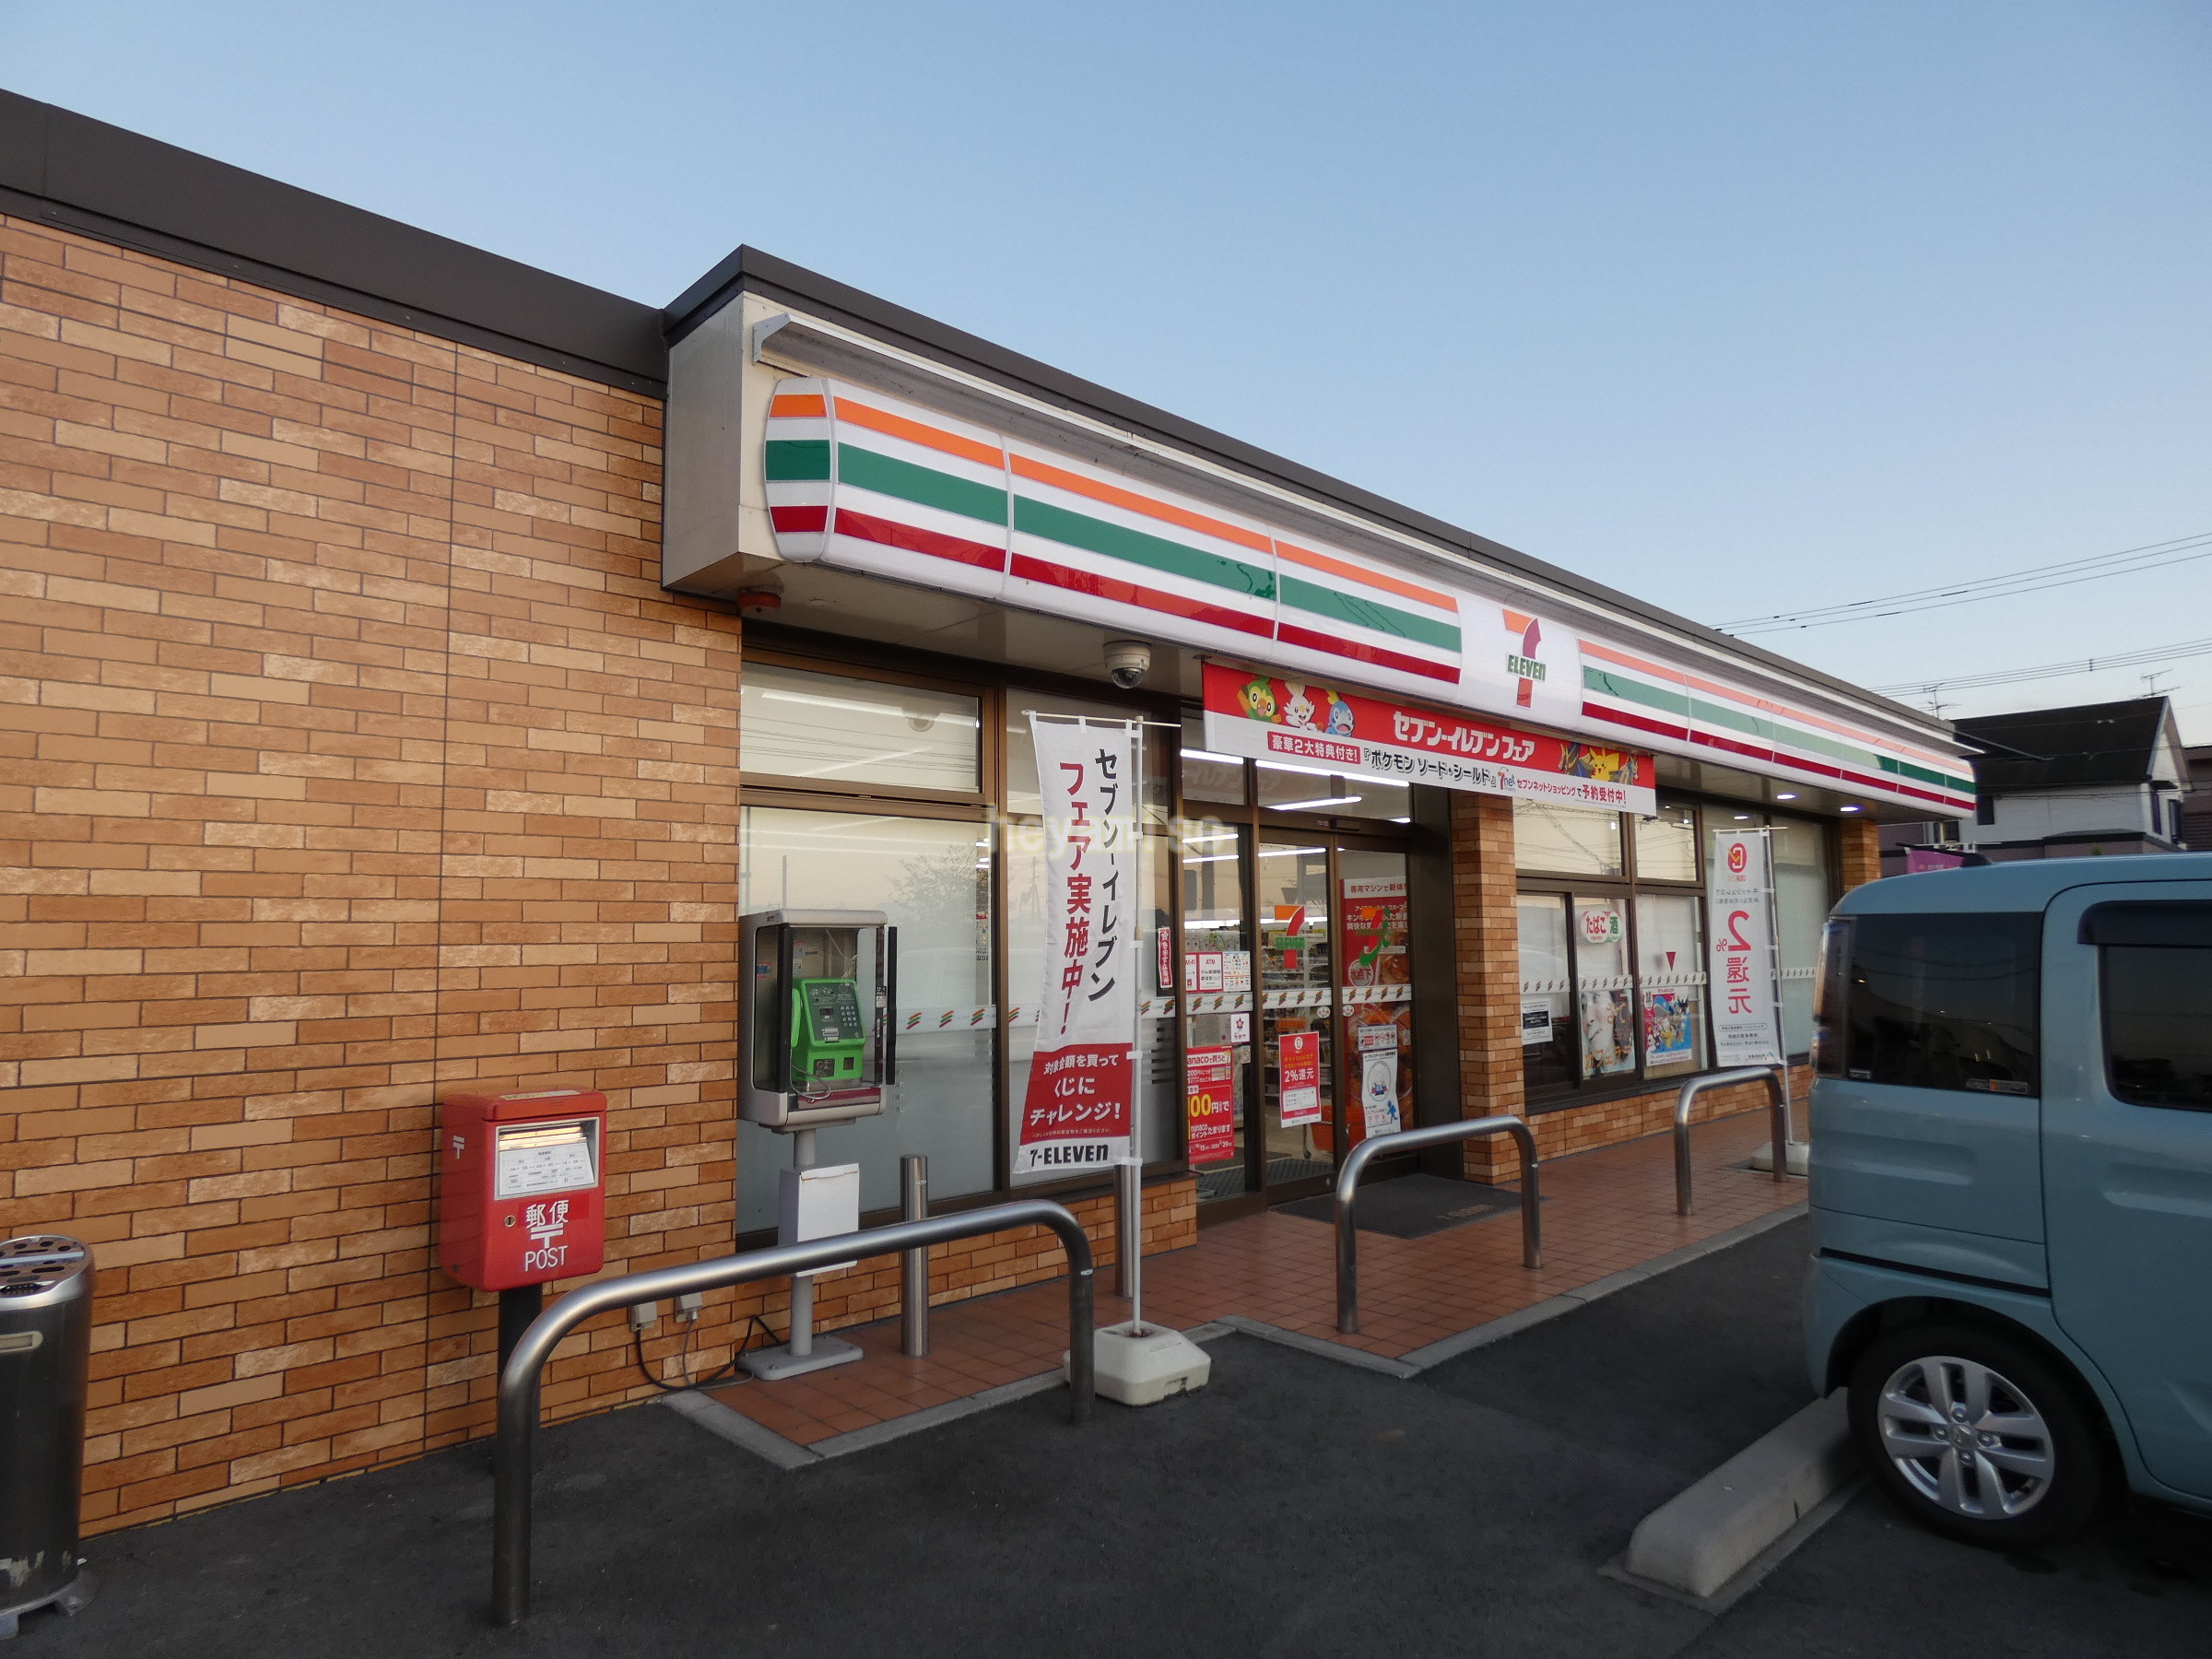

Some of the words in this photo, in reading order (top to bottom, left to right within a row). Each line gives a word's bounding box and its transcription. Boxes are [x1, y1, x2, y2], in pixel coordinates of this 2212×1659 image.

[1586, 915, 1606, 934] たばこ
[1609, 916, 1618, 934] 酒
[1043, 1053, 1119, 1075] 対象金額を買って
[1187, 1054, 1226, 1065] anacoで買うと
[1285, 1068, 1314, 1083] 2%還元
[1054, 1077, 1096, 1098] くじに
[1030, 1101, 1121, 1126] チャレンジ!
[525, 1199, 570, 1229] 郵便
[524, 1245, 569, 1272] POST
